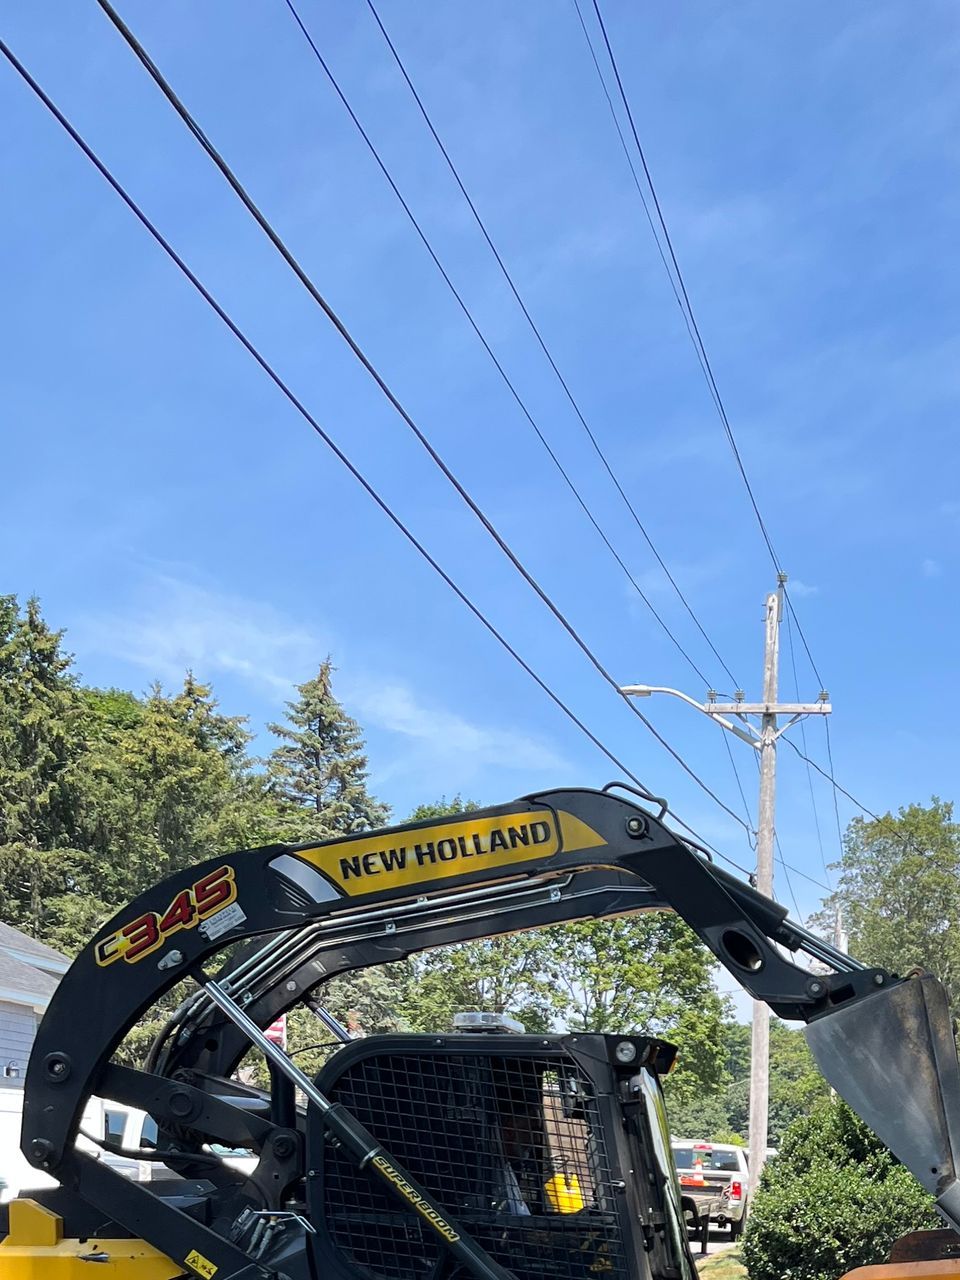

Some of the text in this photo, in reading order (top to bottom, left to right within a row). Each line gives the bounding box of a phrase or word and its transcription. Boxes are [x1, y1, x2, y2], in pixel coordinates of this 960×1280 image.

[339, 820, 550, 879] NEW HOLLAND
[96, 865, 237, 967] C345
[373, 1156, 460, 1241] SUPER BOOM
